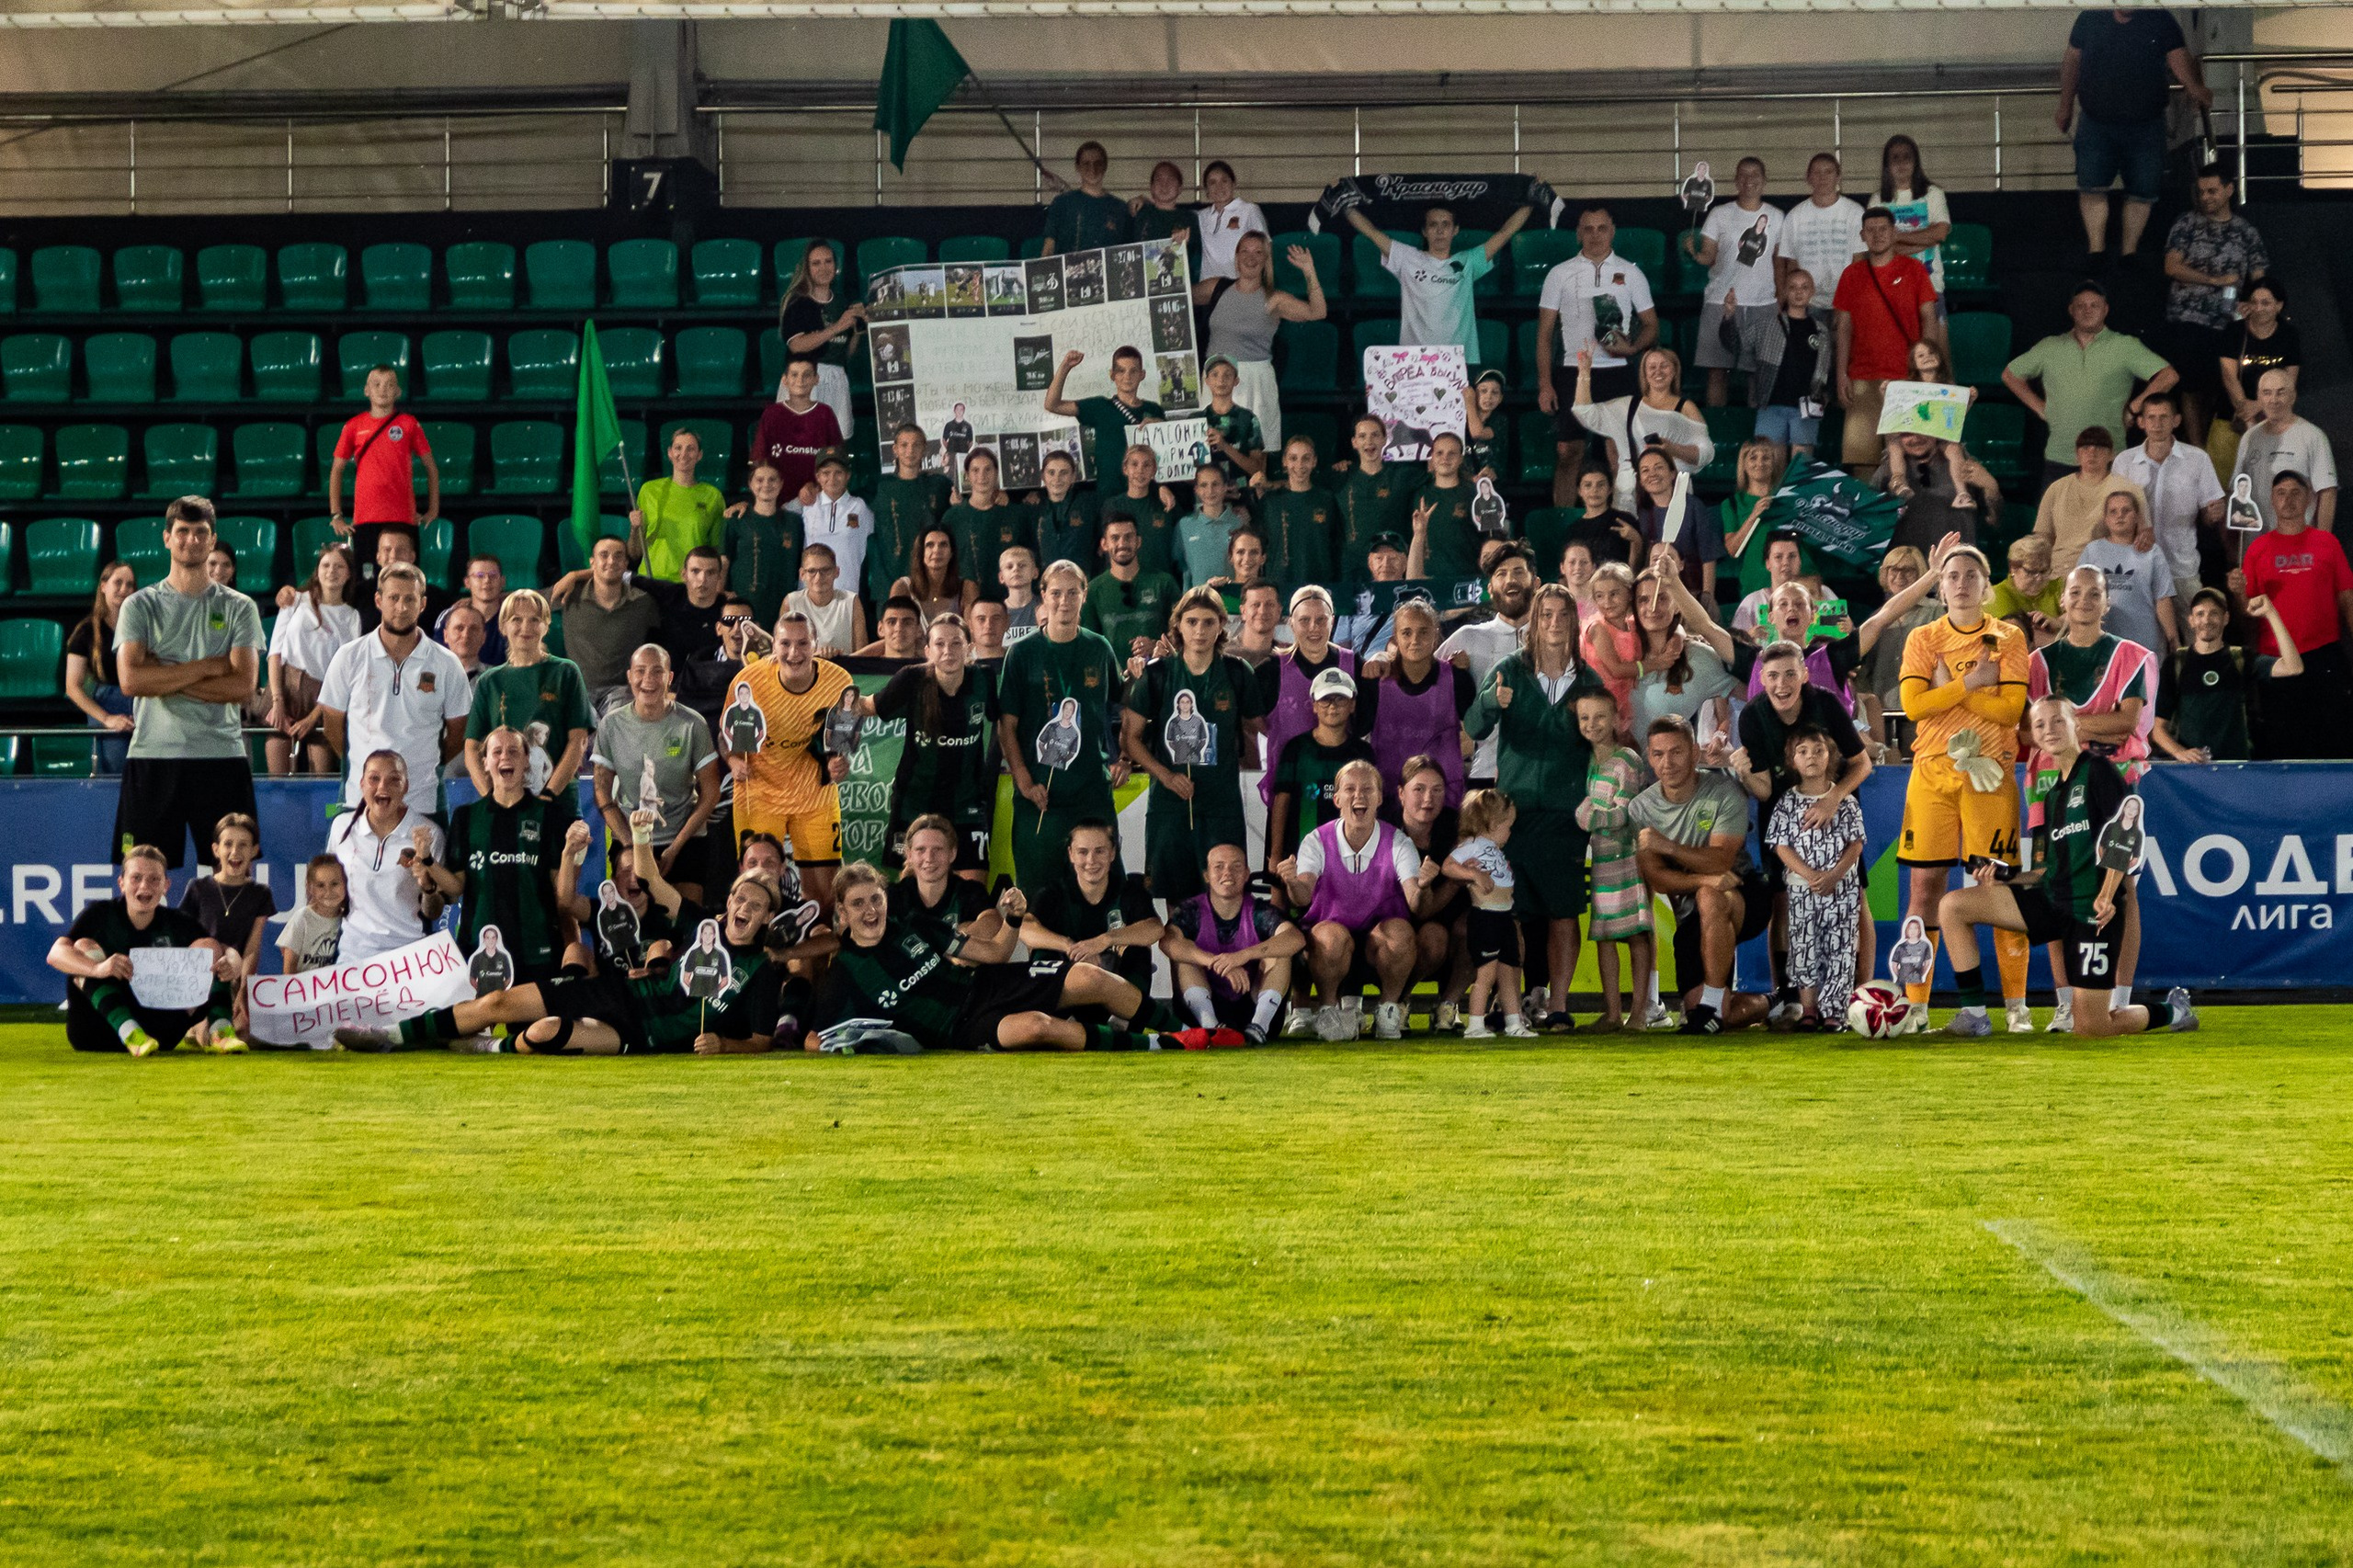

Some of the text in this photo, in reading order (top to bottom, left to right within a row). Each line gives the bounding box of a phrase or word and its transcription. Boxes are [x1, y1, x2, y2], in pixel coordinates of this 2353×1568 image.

[643, 172, 662, 199] 7
[1375, 175, 1488, 200] Краснодар
[1989, 828, 2018, 860] 44
[2231, 903, 2333, 931] лига
[253, 943, 460, 1007] САМСОНЮК
[899, 952, 941, 992] Constell
[2079, 942, 2109, 976] 75
[293, 986, 426, 1034] ВПЕРЁД
